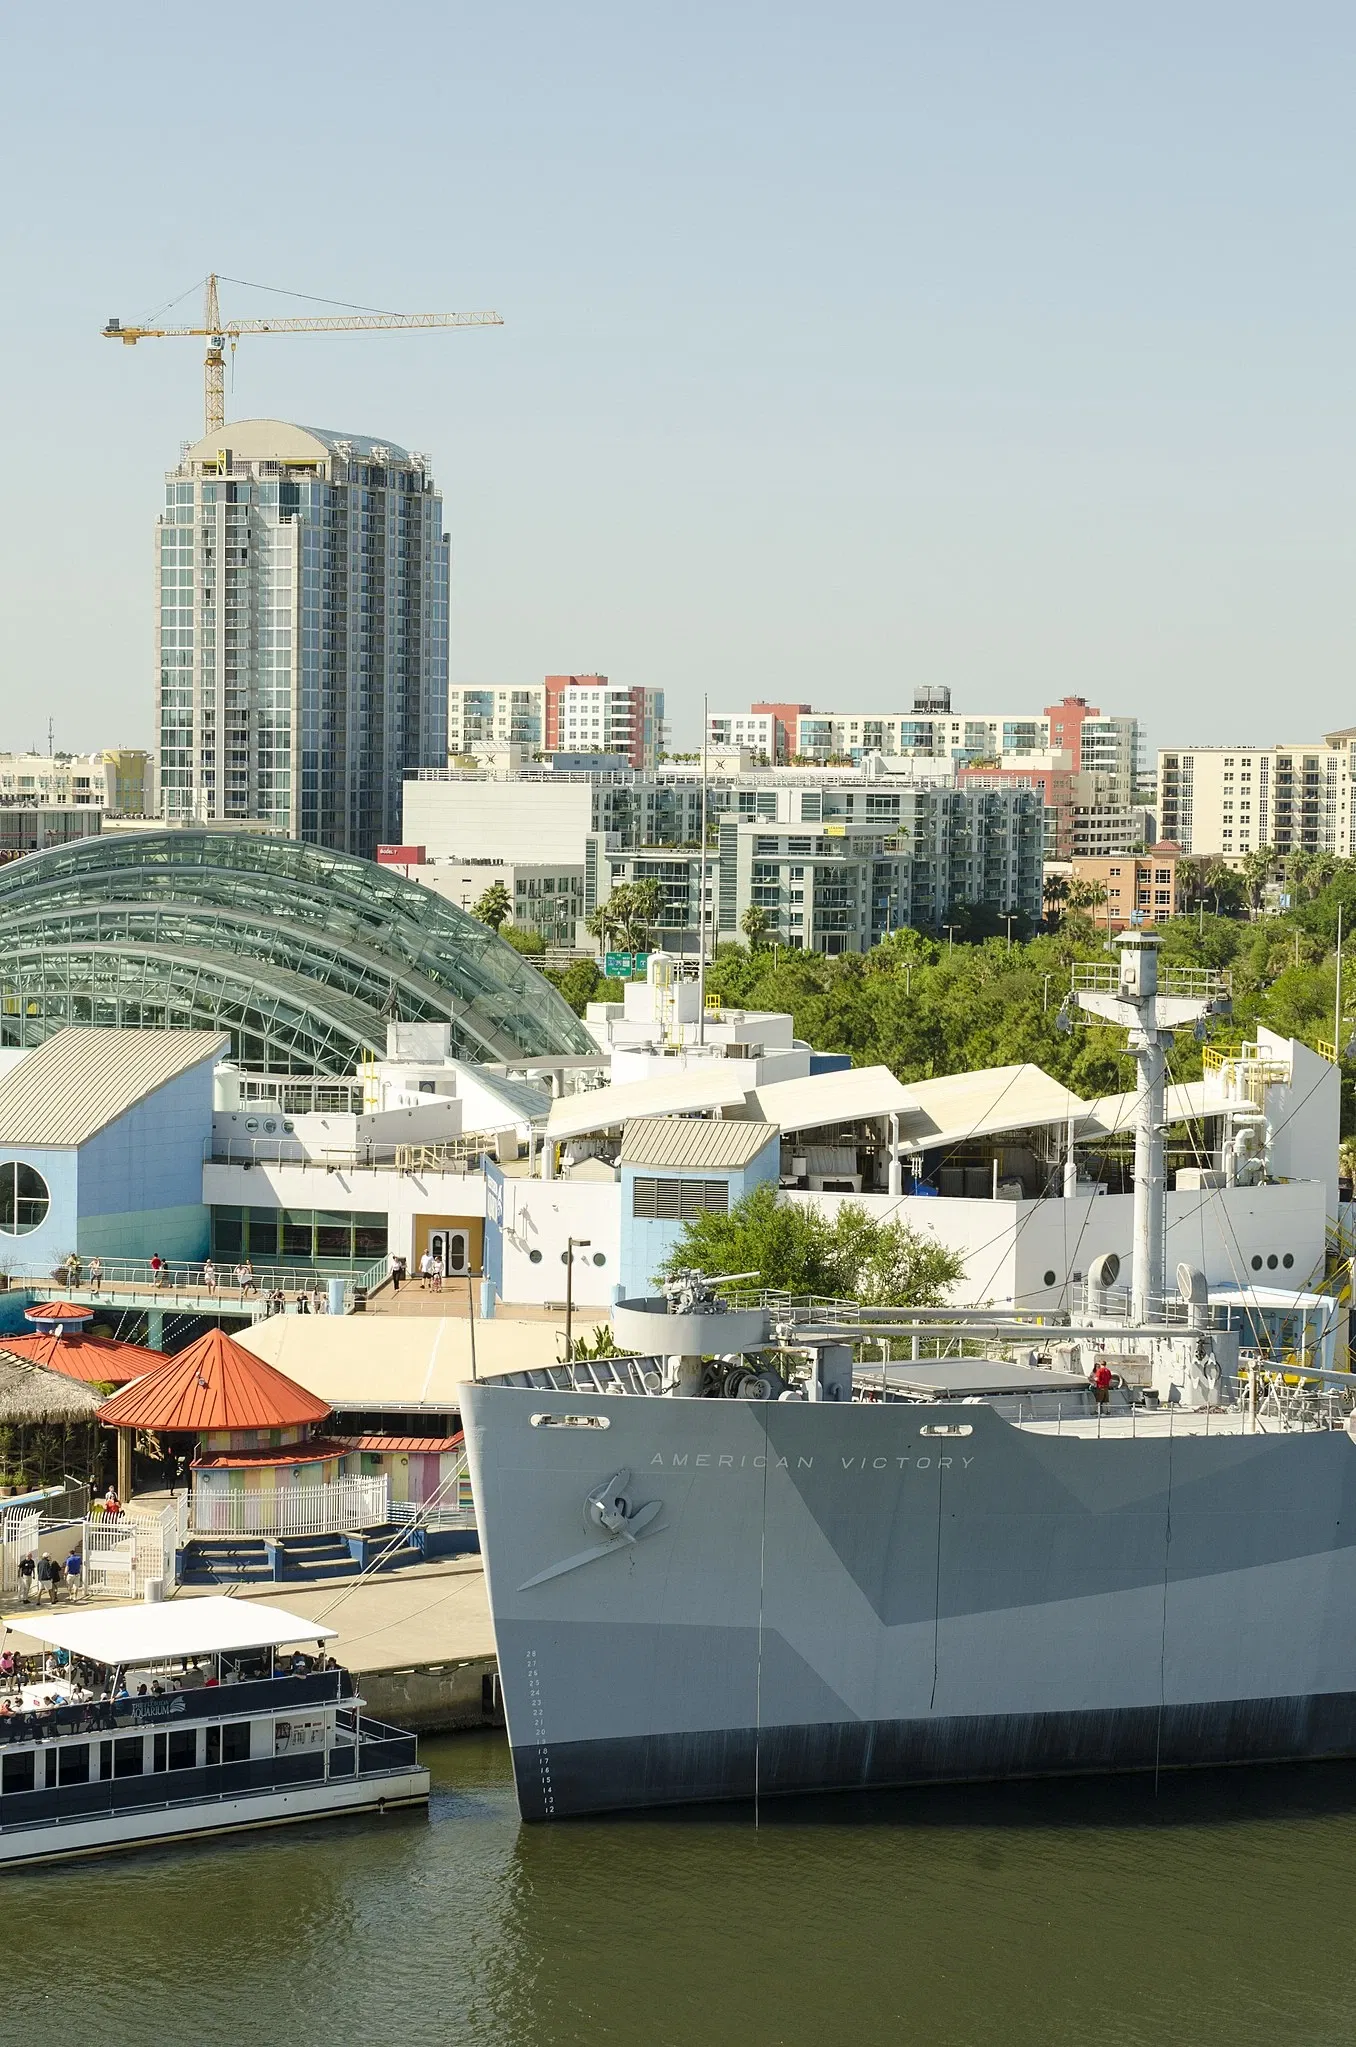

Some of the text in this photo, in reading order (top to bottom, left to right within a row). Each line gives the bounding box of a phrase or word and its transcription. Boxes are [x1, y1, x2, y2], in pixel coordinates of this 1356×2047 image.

[650, 1453, 975, 1469] AMERICAN VICTORY
[131, 1705, 169, 1719] AQUARIUM
[538, 1747, 548, 1755] 18
[543, 1786, 552, 1794] 14
[544, 1796, 554, 1804] 13
